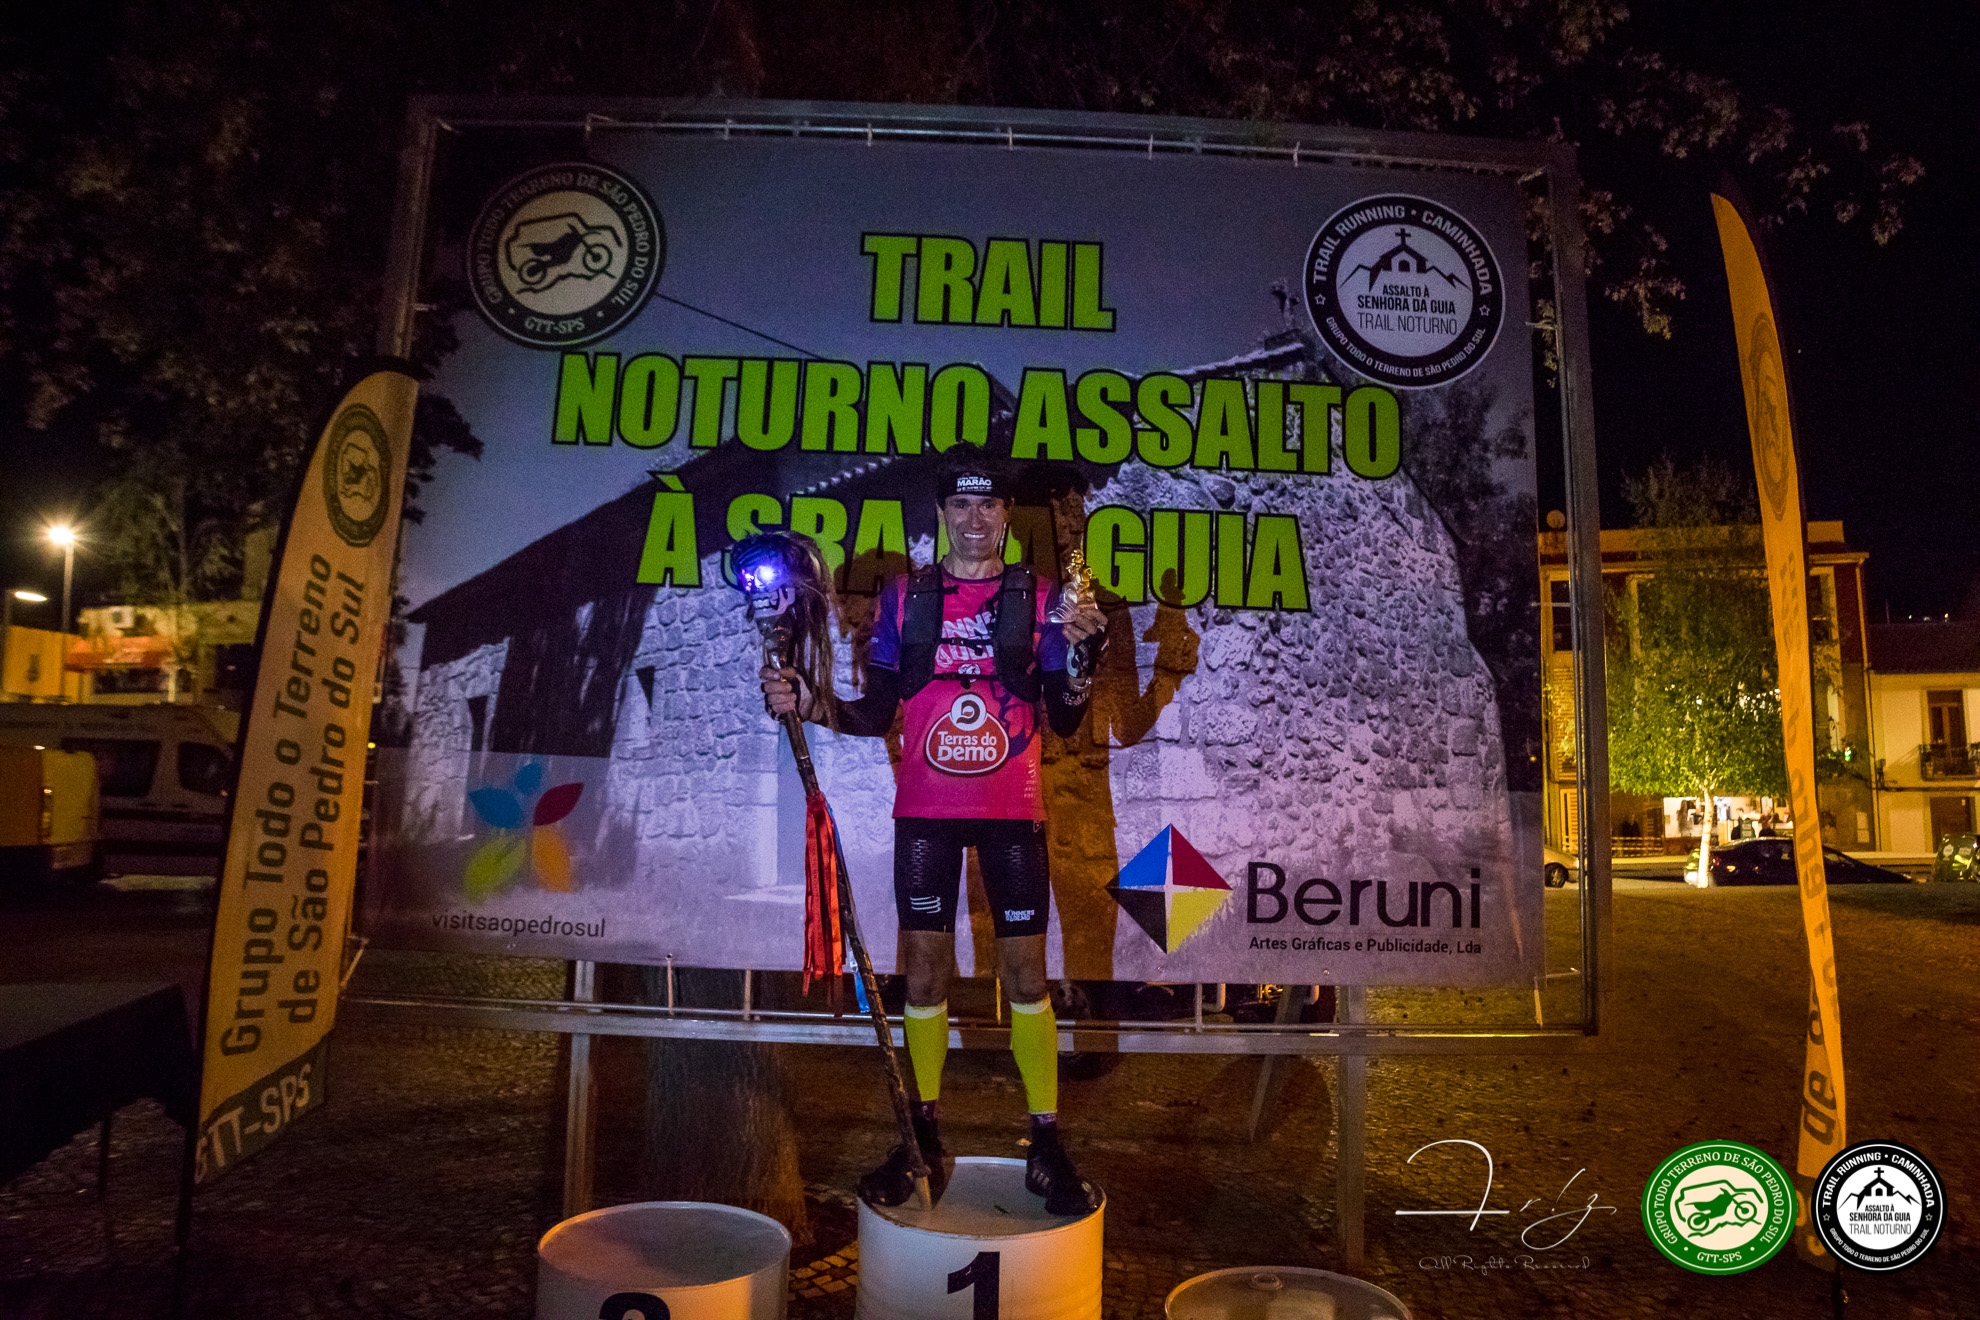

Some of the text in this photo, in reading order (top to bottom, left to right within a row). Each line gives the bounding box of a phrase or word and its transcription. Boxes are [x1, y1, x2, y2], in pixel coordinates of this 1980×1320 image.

[576, 173, 599, 189] DE
[623, 202, 651, 252] PEDRO
[1313, 204, 1493, 296] TRAIL RUNNING CAMINHADA
[611, 279, 640, 307] SUL
[631, 255, 649, 280] DO
[861, 232, 1117, 332] TRAIL
[1382, 283, 1430, 299] ASSALTO À
[524, 315, 586, 334] GTT-SPS
[1357, 295, 1456, 315] SENHORA DA GUIA
[1357, 312, 1458, 335] TRAIL NOTURNO
[1326, 316, 1348, 346] GRUPO
[1346, 342, 1366, 362] TODO
[1374, 360, 1411, 377] TERRENO
[1412, 367, 1424, 377] DE
[1425, 362, 1441, 376] SÃO
[1441, 351, 1467, 372] PEDRO
[1465, 342, 1476, 356] DO
[1472, 327, 1486, 345] SUL
[552, 352, 1403, 480] NOTURNO ASSALTO
[957, 478, 992, 487] MARÃO
[634, 470, 702, 588] À
[1085, 504, 1311, 612] GUIA
[330, 571, 366, 646] Sul
[322, 656, 357, 709] do
[937, 731, 997, 746] Terras do
[937, 745, 998, 761] Demo
[220, 553, 331, 1057] Grupo Todo o Terreno
[300, 722, 347, 851] Pedro
[287, 868, 329, 953] São
[1247, 861, 1481, 928] Beruni
[432, 909, 606, 938] visitsaopedrosul
[1250, 936, 1481, 955] Artes Gráficas e Publicidade, Lda
[278, 969, 321, 1024] de
[193, 1063, 312, 1184] GTT-SPS
[947, 1251, 1000, 1320] 1
